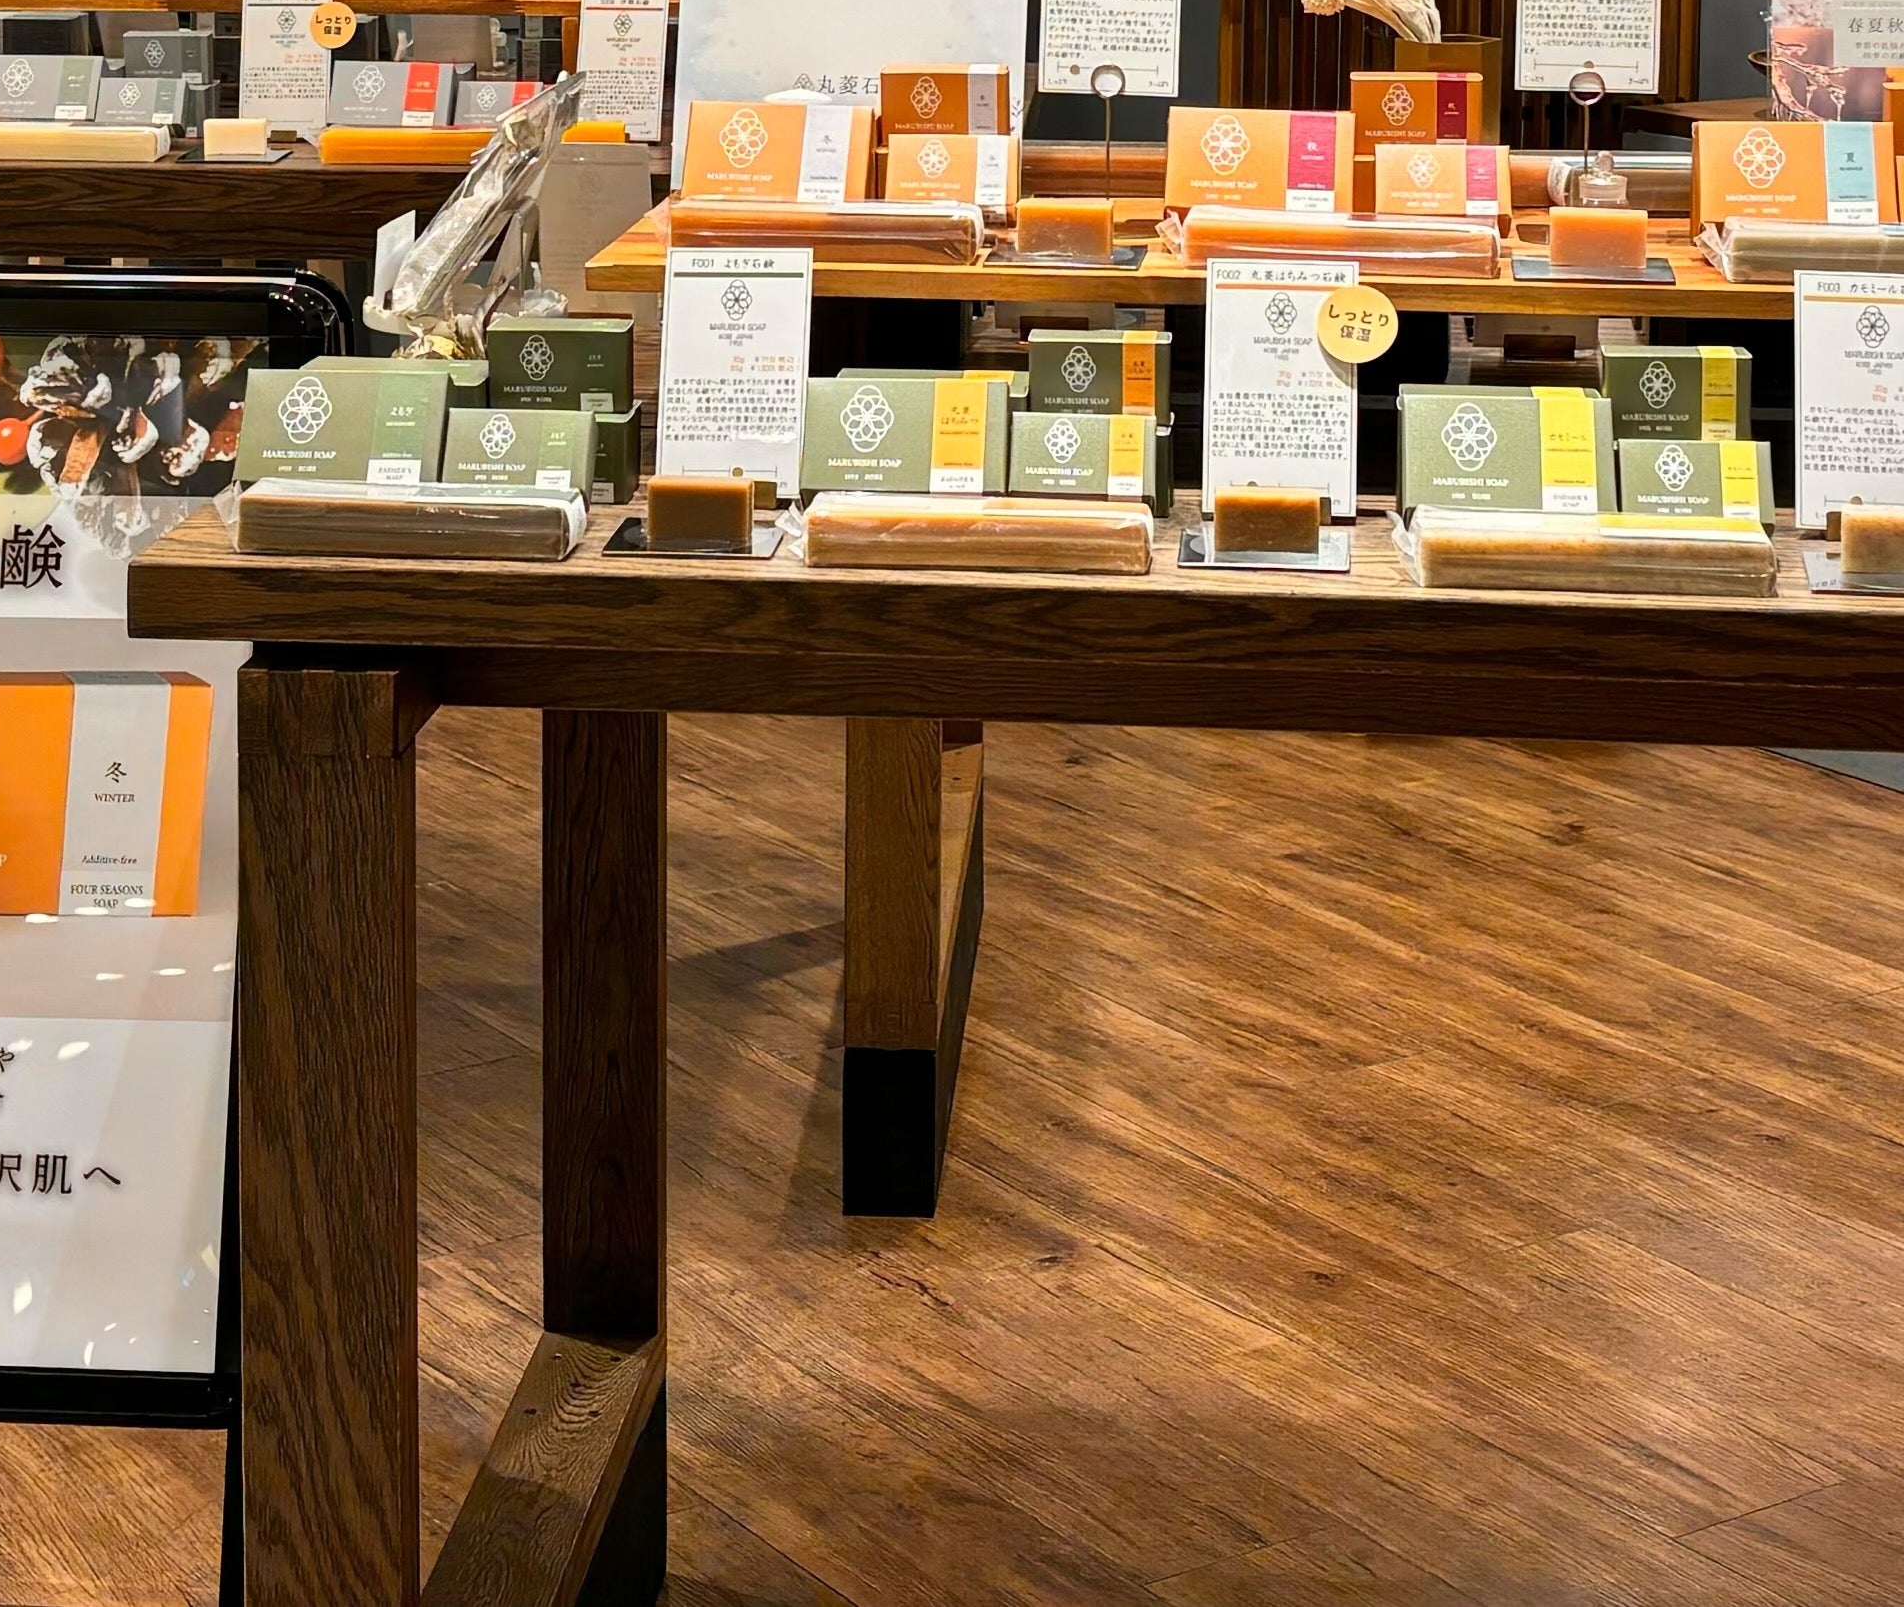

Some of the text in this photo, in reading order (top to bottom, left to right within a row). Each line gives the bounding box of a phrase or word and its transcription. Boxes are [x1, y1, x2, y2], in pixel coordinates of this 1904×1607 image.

[316, 15, 351, 25] しっとり
[692, 258, 775, 269] F001 よもぎ石鹸
[1216, 269, 1346, 283] F002 丸菱はちみつ石鹸
[1817, 282, 1840, 292] F003
[1328, 304, 1389, 327] しっとり
[316, 449, 337, 459] SOAP
[880, 459, 902, 469] SOAP
[1486, 478, 1509, 489] SOAP
[103, 762, 127, 785] 冬
[94, 793, 135, 803] WINTER
[81, 855, 138, 866] Additive-free
[70, 884, 143, 896] FOUR SEASONS
[92, 898, 118, 909] SOAP
